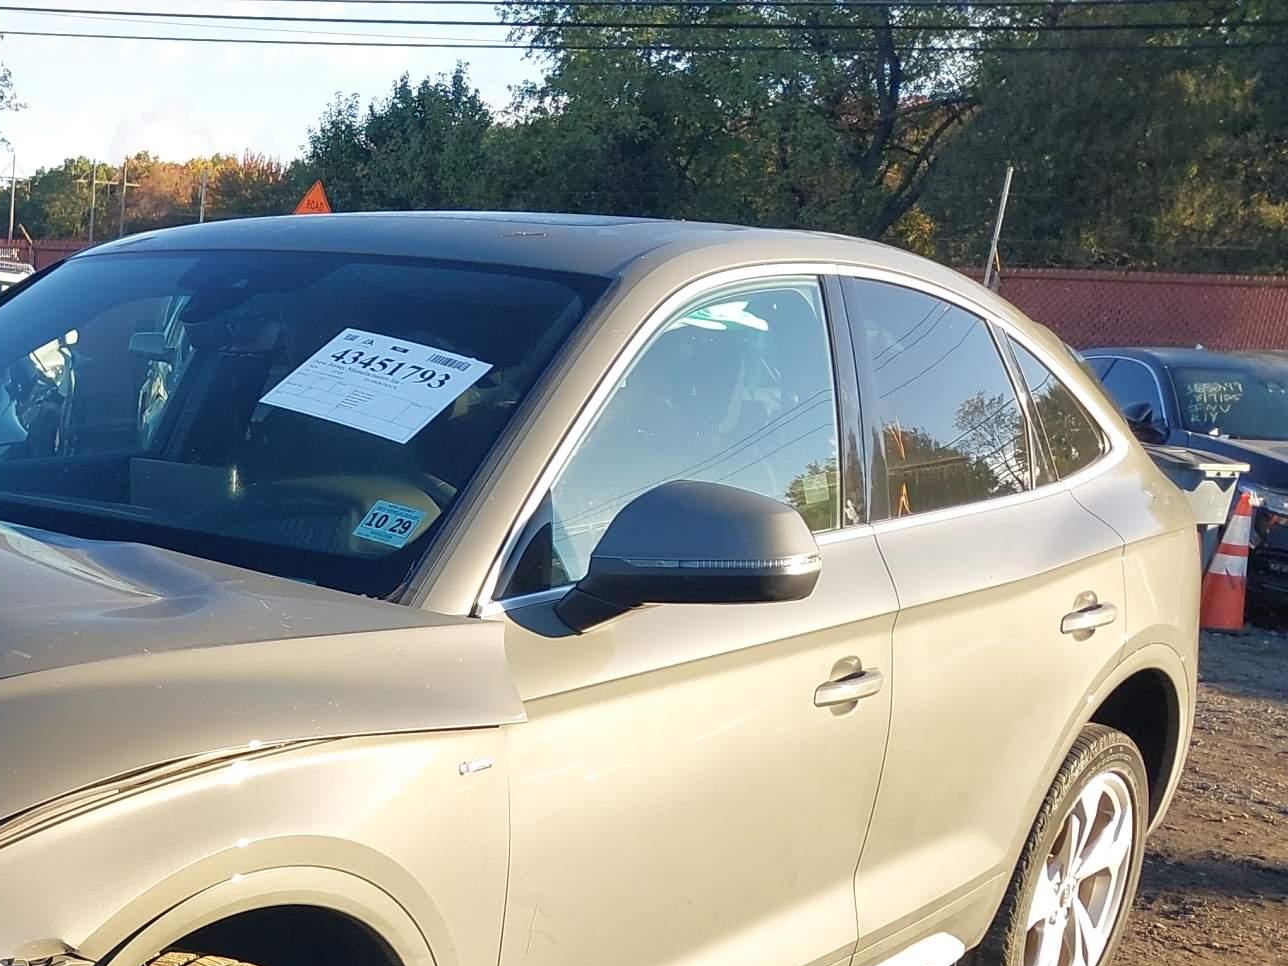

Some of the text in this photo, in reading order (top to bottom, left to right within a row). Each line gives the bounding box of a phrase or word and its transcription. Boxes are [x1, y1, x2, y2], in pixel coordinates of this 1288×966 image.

[307, 199, 324, 212] ROAD
[328, 362, 345, 371] Jersey
[330, 348, 451, 389] 43451793
[365, 511, 389, 529] 10
[388, 517, 412, 535] 29
